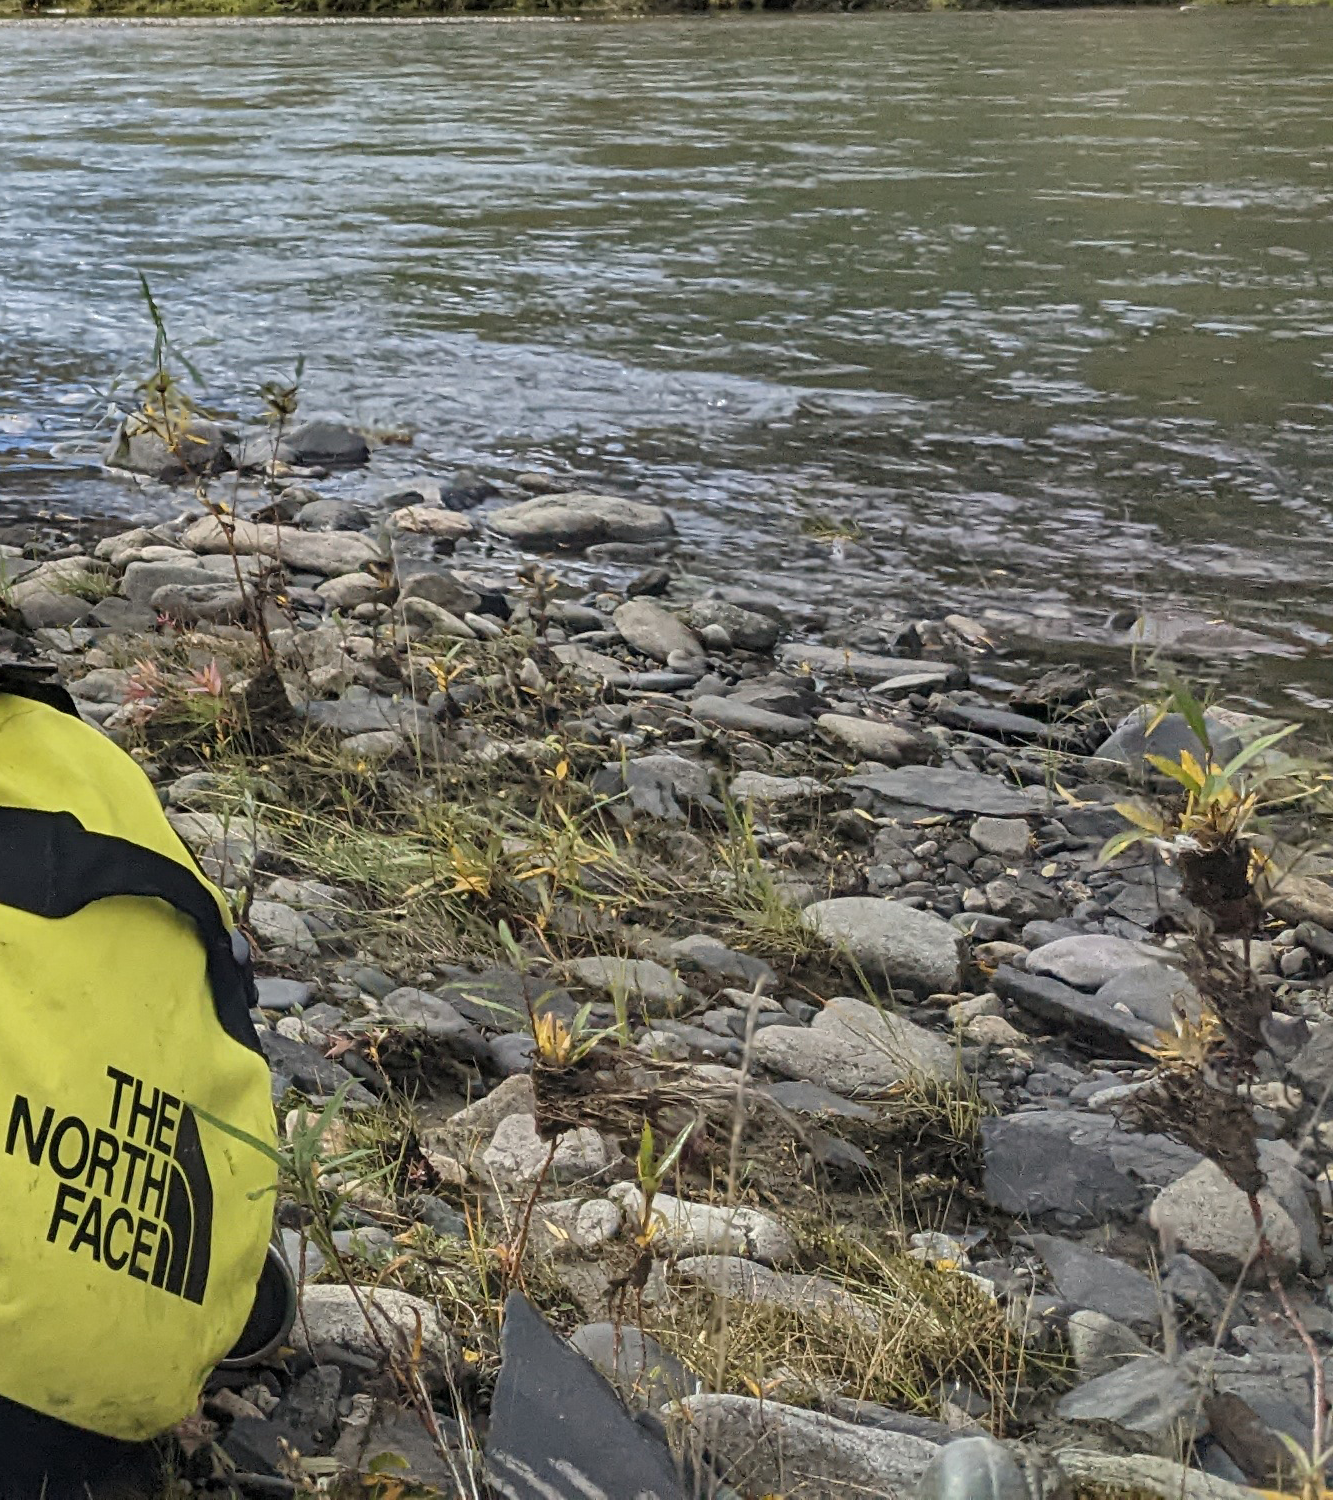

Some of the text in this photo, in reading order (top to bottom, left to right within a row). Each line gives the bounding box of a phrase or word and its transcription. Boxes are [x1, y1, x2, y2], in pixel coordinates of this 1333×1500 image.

[4, 1094, 169, 1219] NORTH
[106, 1065, 181, 1157] THE
[46, 1182, 159, 1283] FACE
